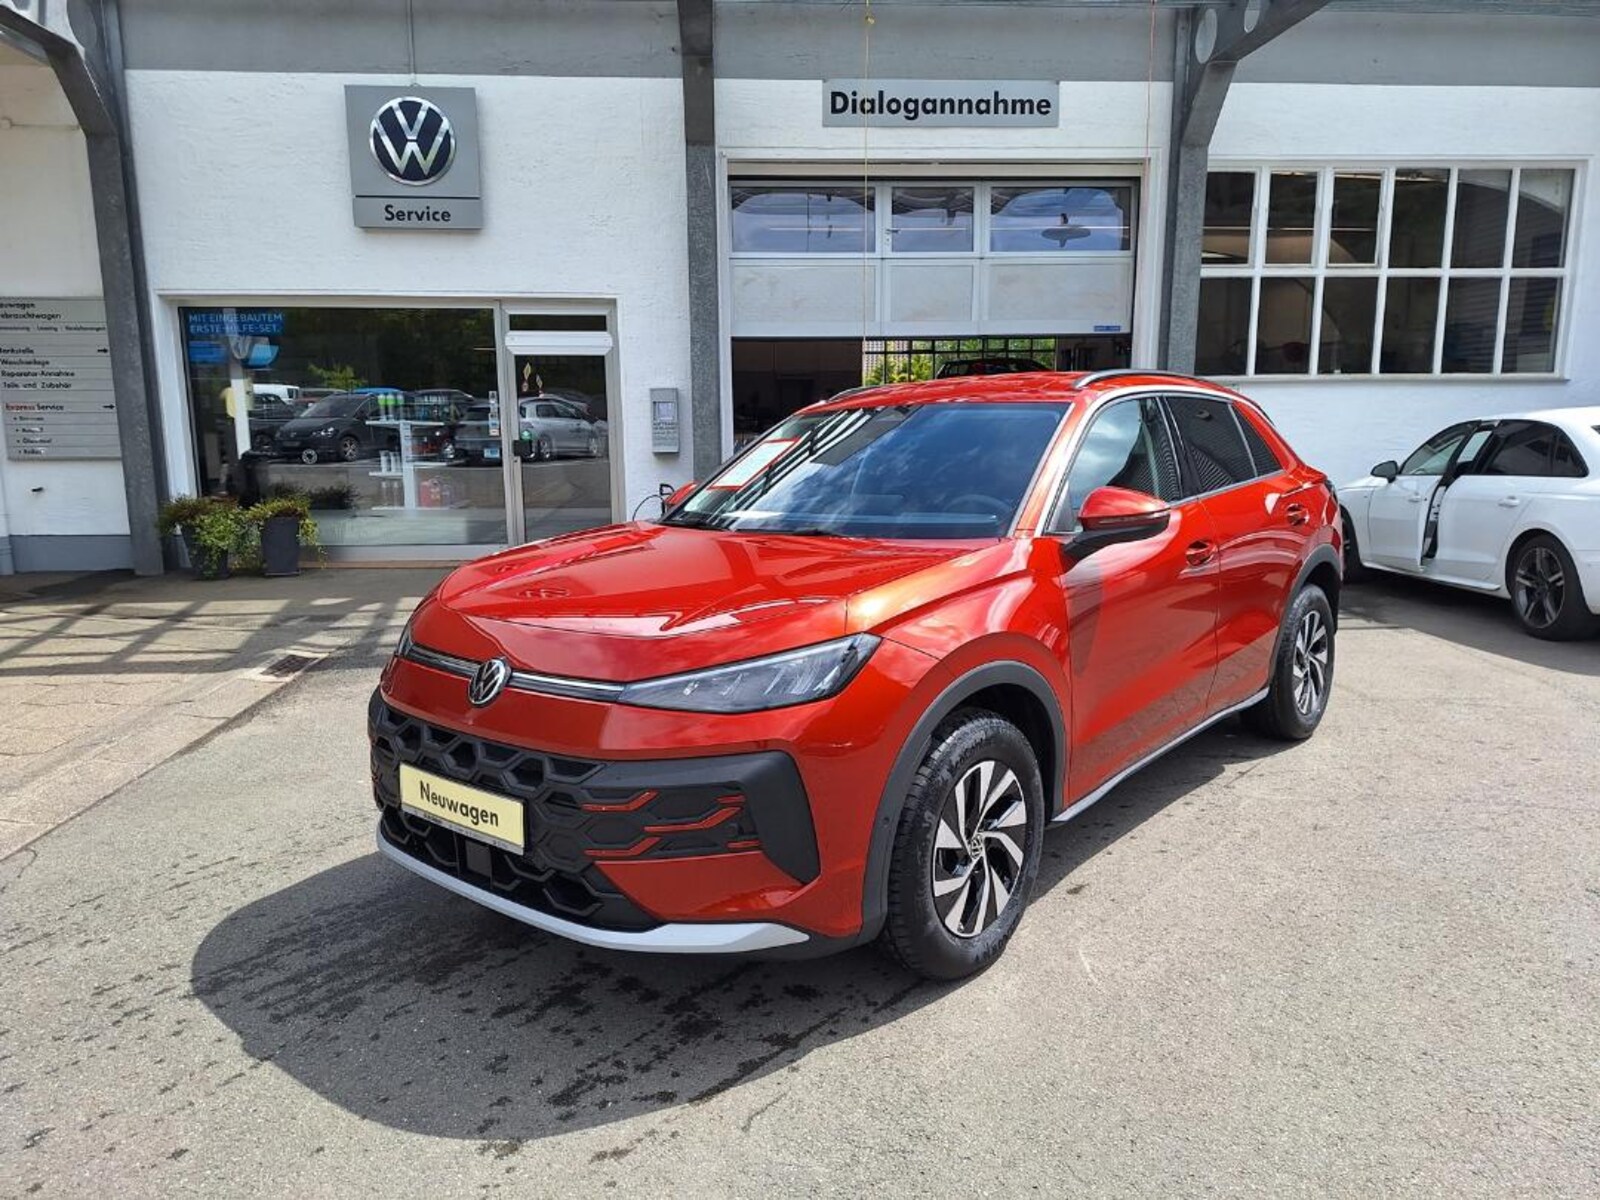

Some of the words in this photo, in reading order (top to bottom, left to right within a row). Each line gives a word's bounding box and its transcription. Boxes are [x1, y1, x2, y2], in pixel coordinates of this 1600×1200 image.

[830, 90, 1052, 121] Dialogannahme
[384, 204, 452, 222] Service
[0, 312, 61, 320] ebrauchtwagen
[189, 313, 206, 323] MIT
[209, 313, 282, 323] EINGEBAUTEM
[37, 402, 64, 410] Service
[419, 780, 500, 827] Neuwagen
